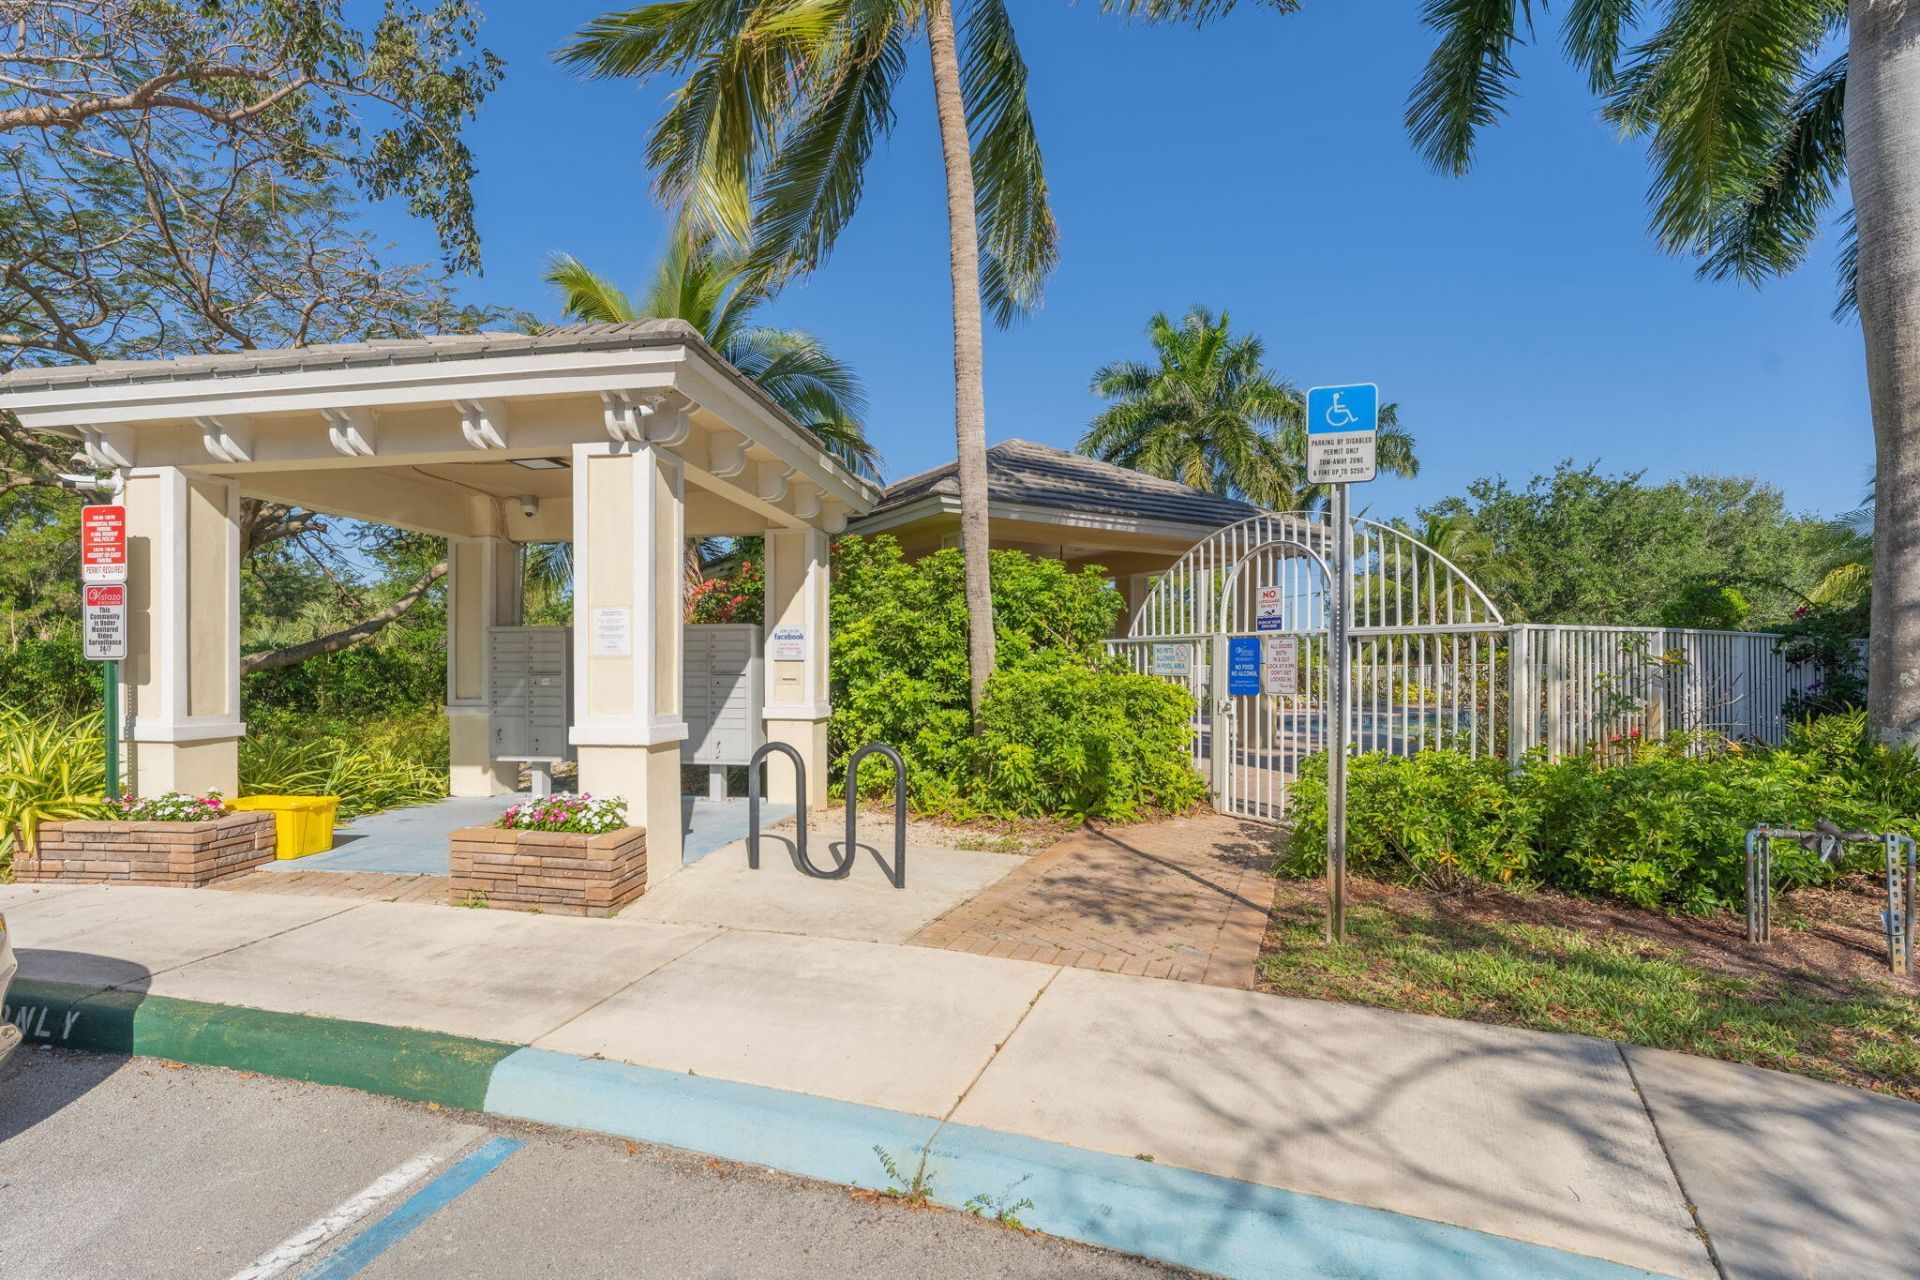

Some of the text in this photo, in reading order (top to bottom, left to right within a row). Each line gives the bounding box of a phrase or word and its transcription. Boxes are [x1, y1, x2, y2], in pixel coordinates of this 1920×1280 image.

[103, 566, 124, 574] REQUIRED
[1263, 590, 1276, 598] NO
[5, 1004, 80, 1040] NLY
